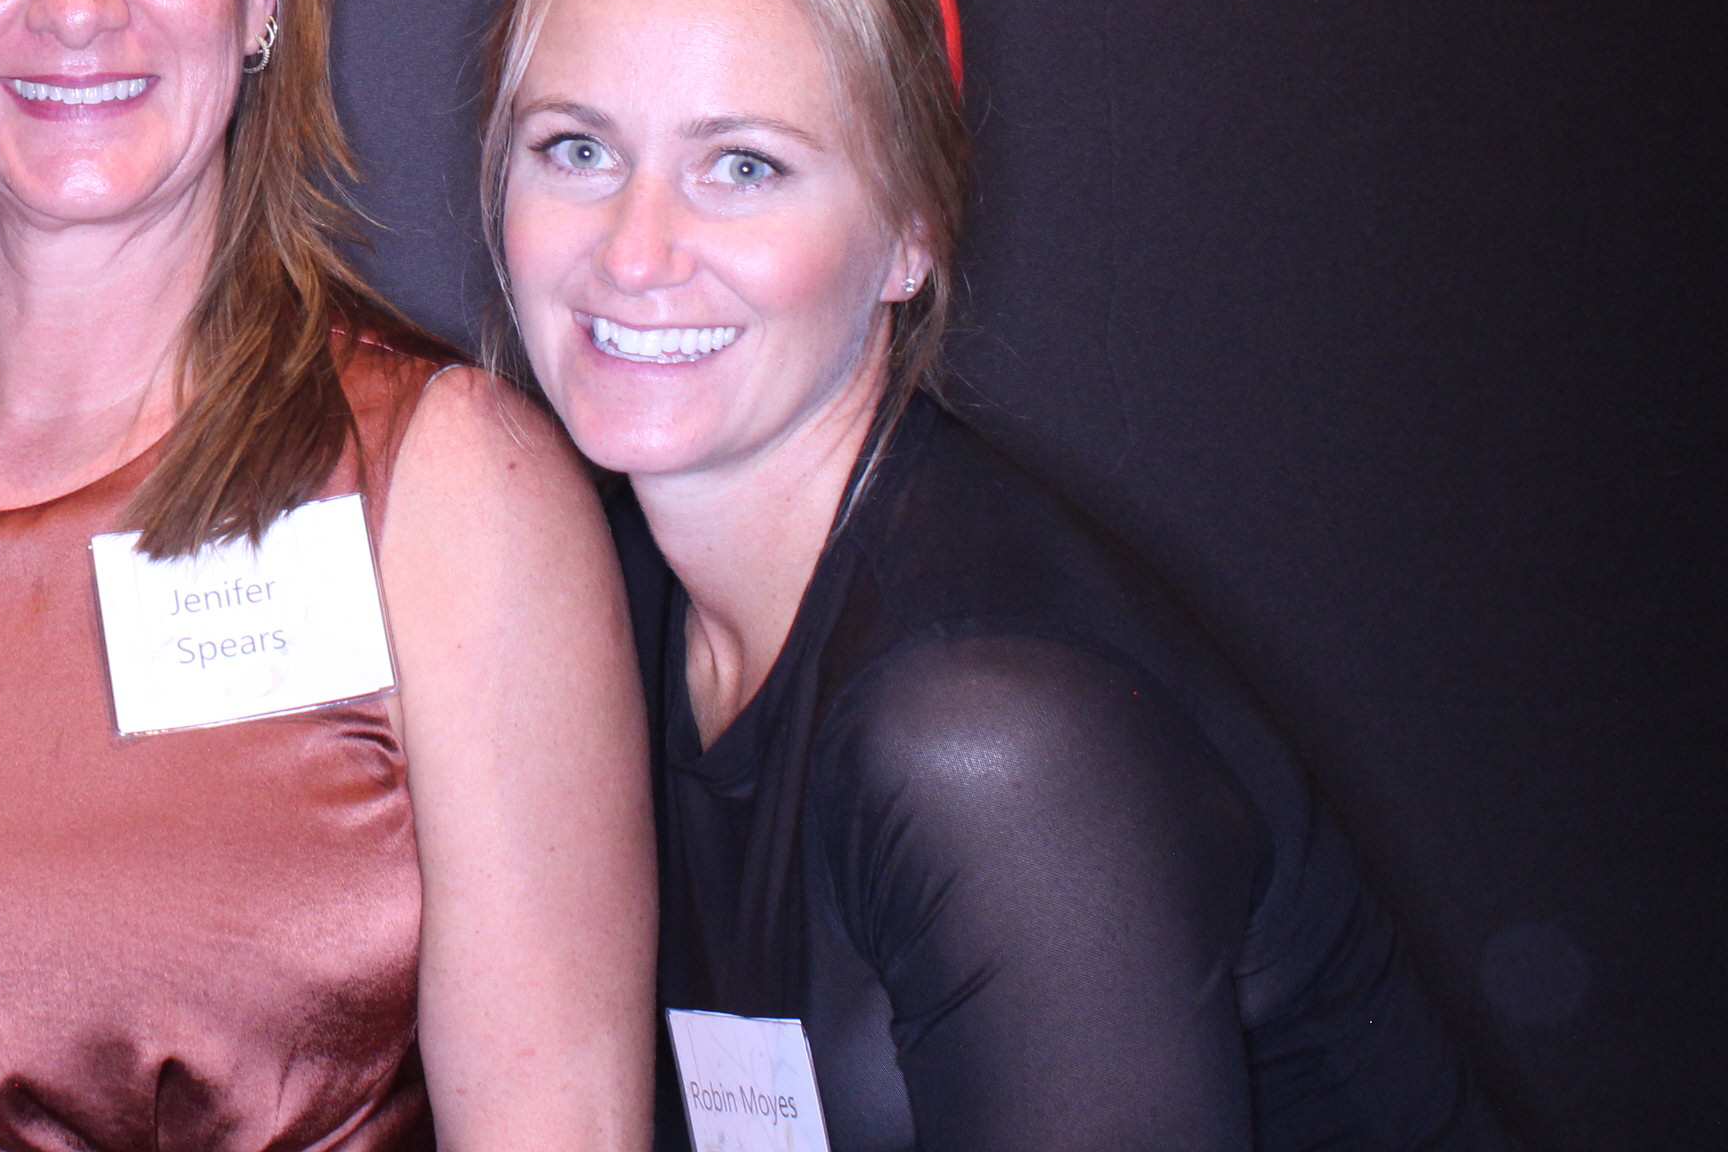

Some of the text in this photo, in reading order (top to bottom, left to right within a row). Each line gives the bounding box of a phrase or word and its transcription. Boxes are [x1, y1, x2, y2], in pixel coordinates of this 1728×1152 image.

[171, 578, 276, 616] Jenifer
[177, 629, 286, 669] Spears
[690, 1080, 798, 1125] Robin Moyes
